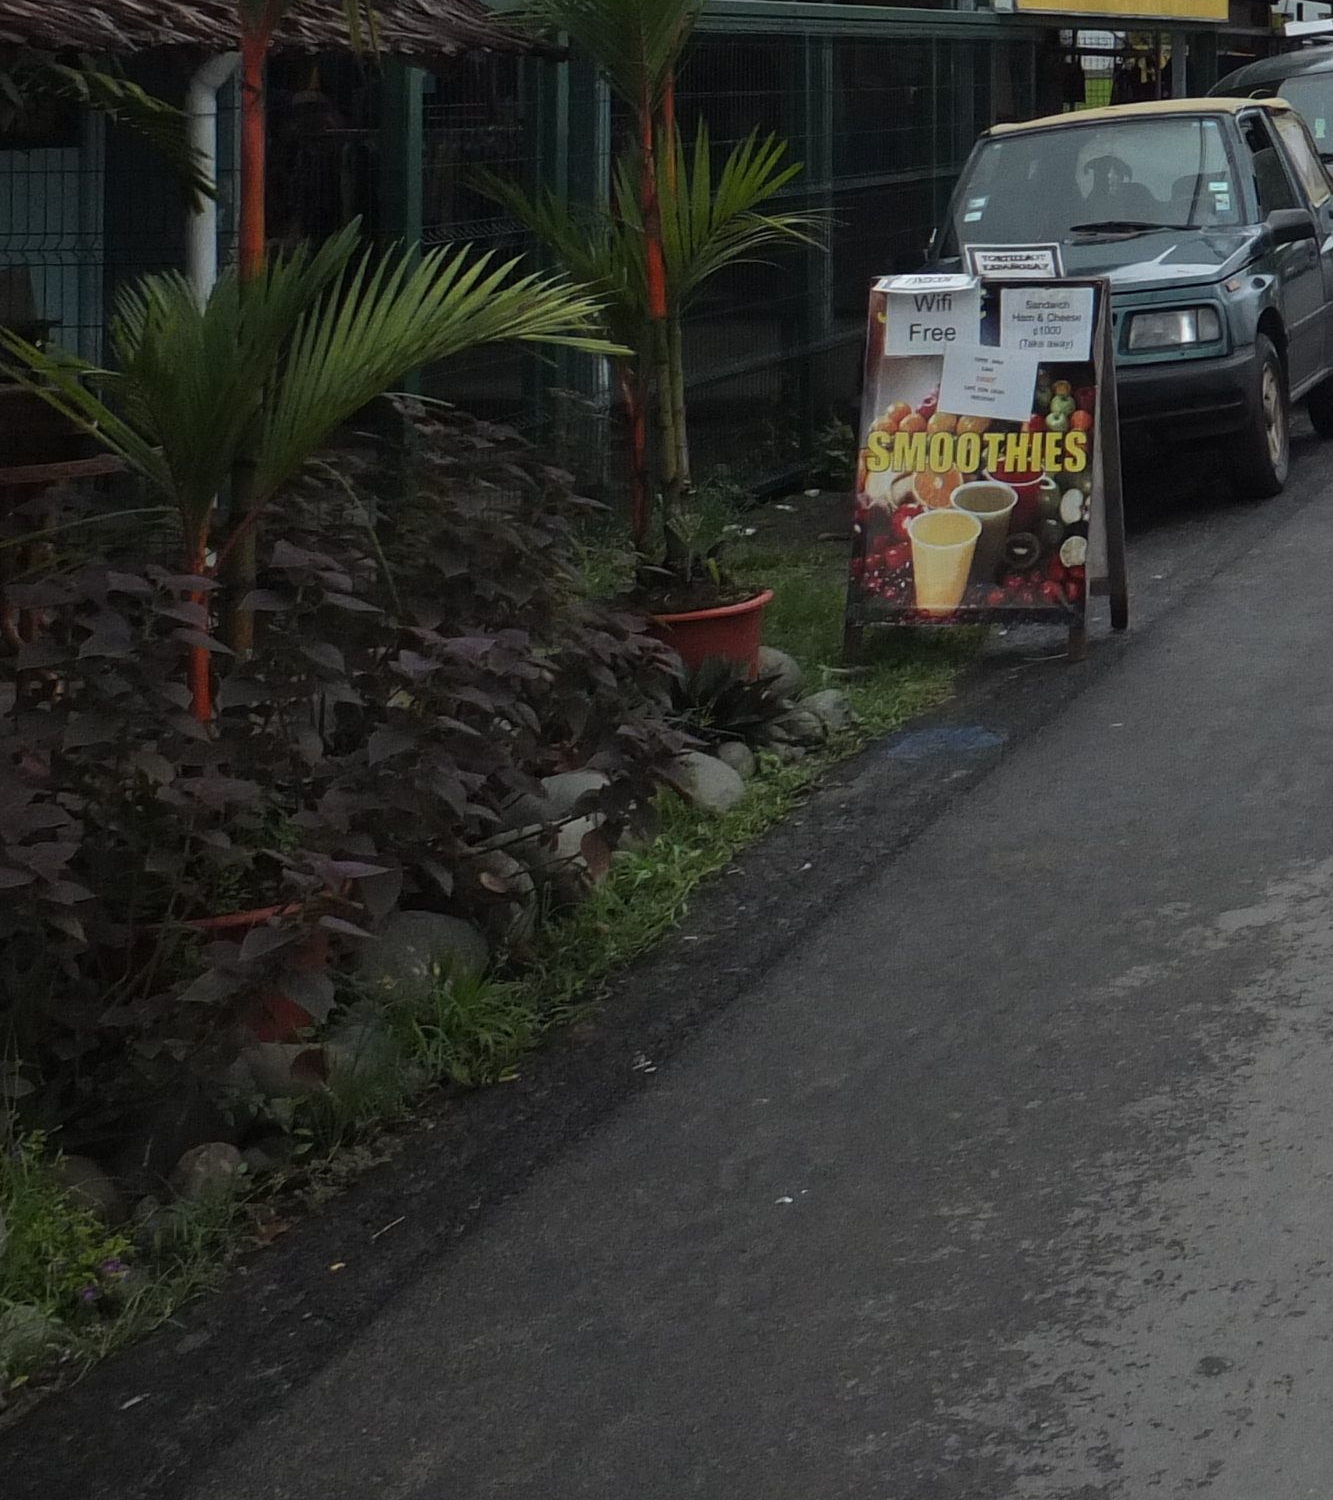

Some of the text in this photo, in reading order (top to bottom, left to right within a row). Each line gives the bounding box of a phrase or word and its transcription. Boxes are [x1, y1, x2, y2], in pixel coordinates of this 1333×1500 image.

[913, 293, 953, 313] Wifi
[1025, 299, 1071, 311] Sandwich
[1012, 312, 1082, 323] Ham & Cheese
[909, 323, 957, 342] Free
[1019, 339, 1074, 350] (Take away)
[866, 429, 1088, 474] SMOOTHIES
